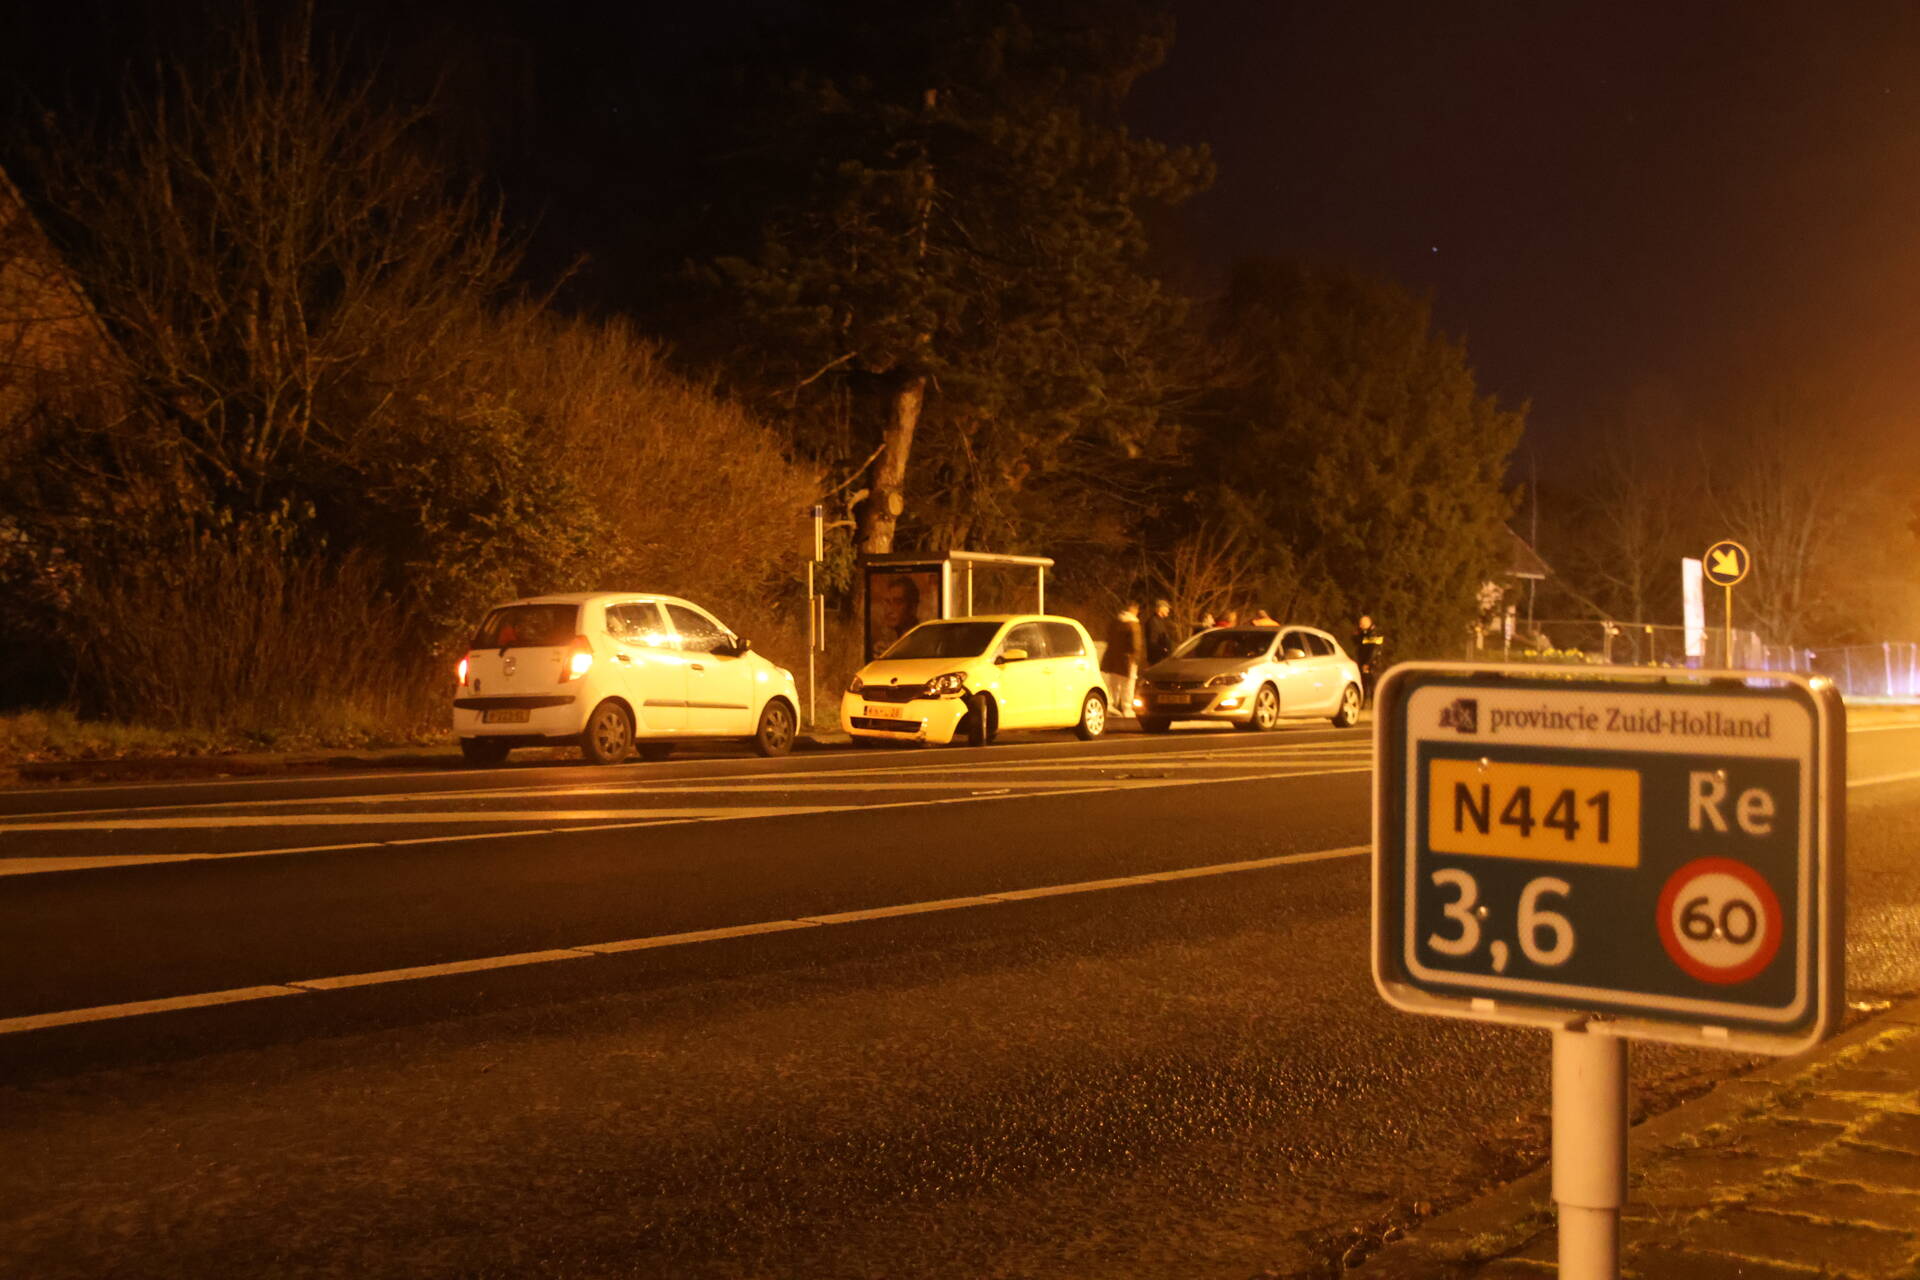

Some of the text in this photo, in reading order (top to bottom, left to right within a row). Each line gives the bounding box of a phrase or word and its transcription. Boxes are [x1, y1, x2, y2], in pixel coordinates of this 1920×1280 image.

[1490, 705, 1770, 738] provincie Zuid-Holland
[1454, 783, 1610, 843] N441
[1689, 770, 1775, 835] Re
[1428, 869, 1575, 972] 3,6
[1680, 896, 1757, 944] 60
